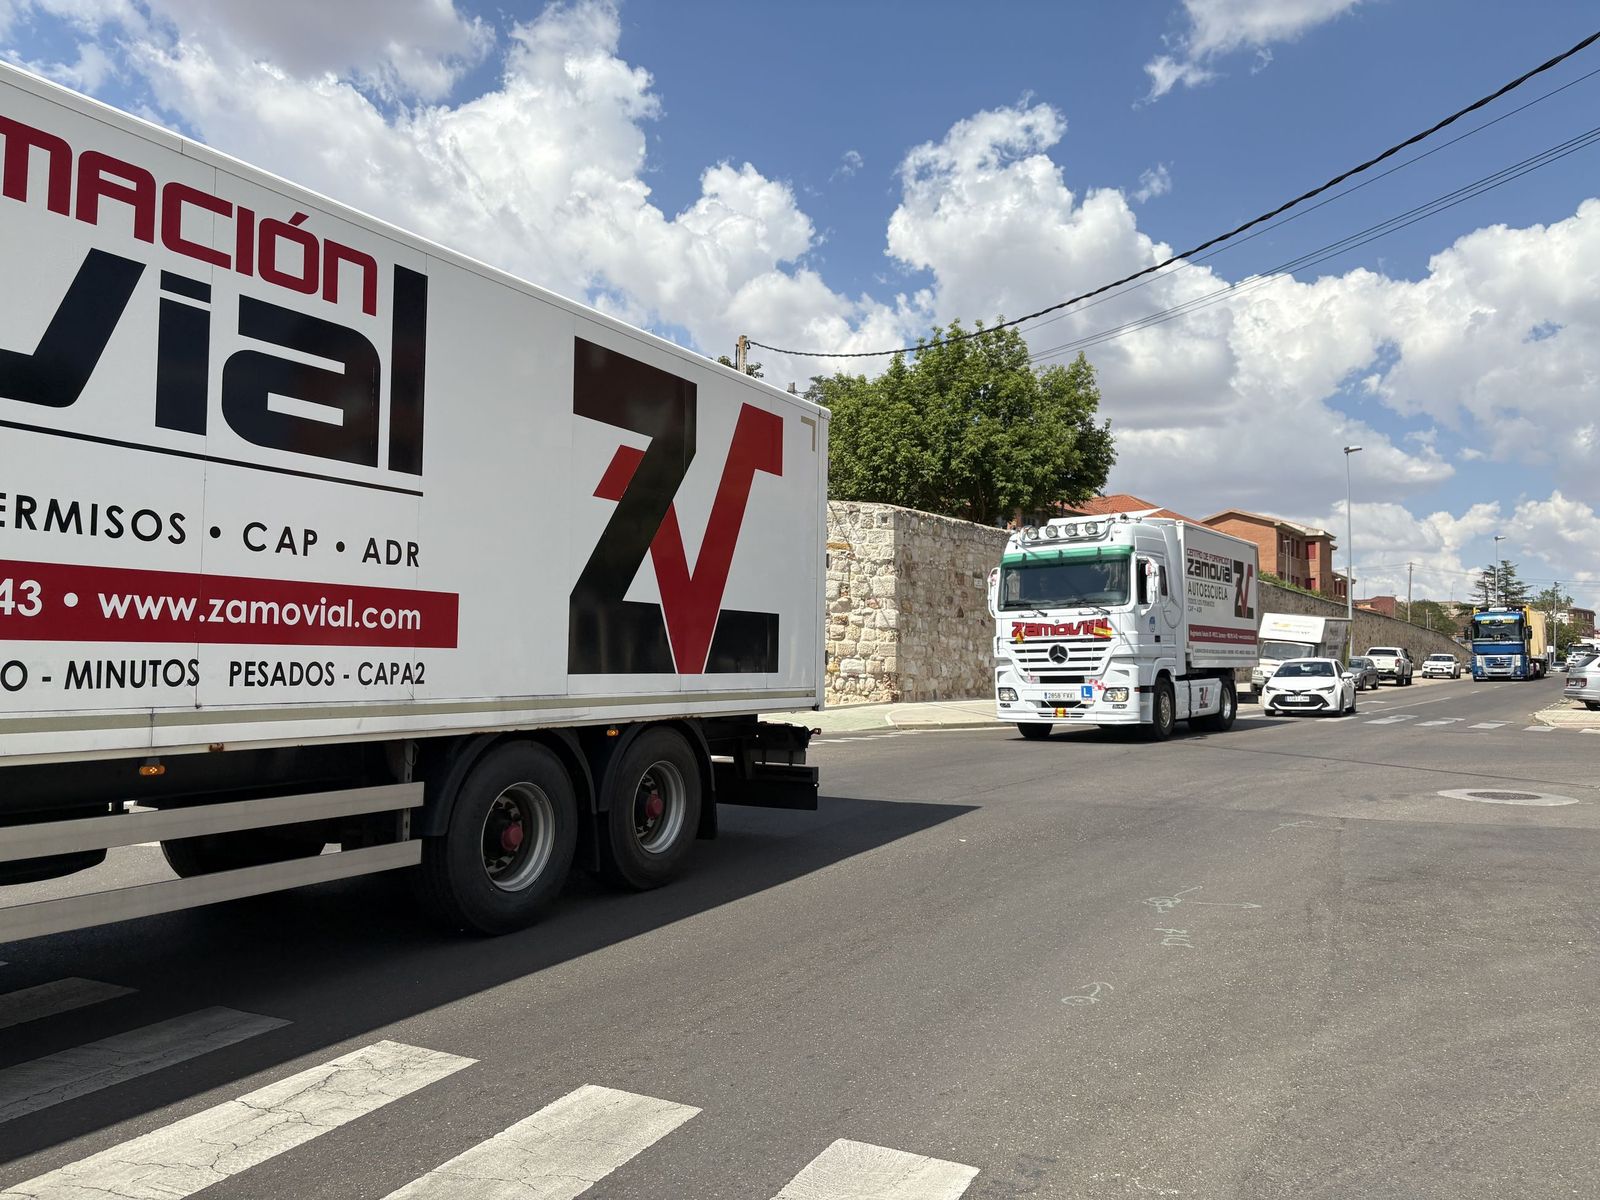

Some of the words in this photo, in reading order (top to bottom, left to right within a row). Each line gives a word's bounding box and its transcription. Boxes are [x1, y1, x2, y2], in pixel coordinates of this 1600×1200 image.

[243, 521, 319, 557] CAP
[361, 537, 420, 568] ADR
[1187, 581, 1229, 601] AUTOESCUELA
[98, 591, 422, 631] www.zamovial.com
[0, 660, 29, 692] O
[64, 658, 200, 690] MINUTOS
[229, 661, 335, 687] PESADOS
[357, 661, 426, 686] CAPA2
